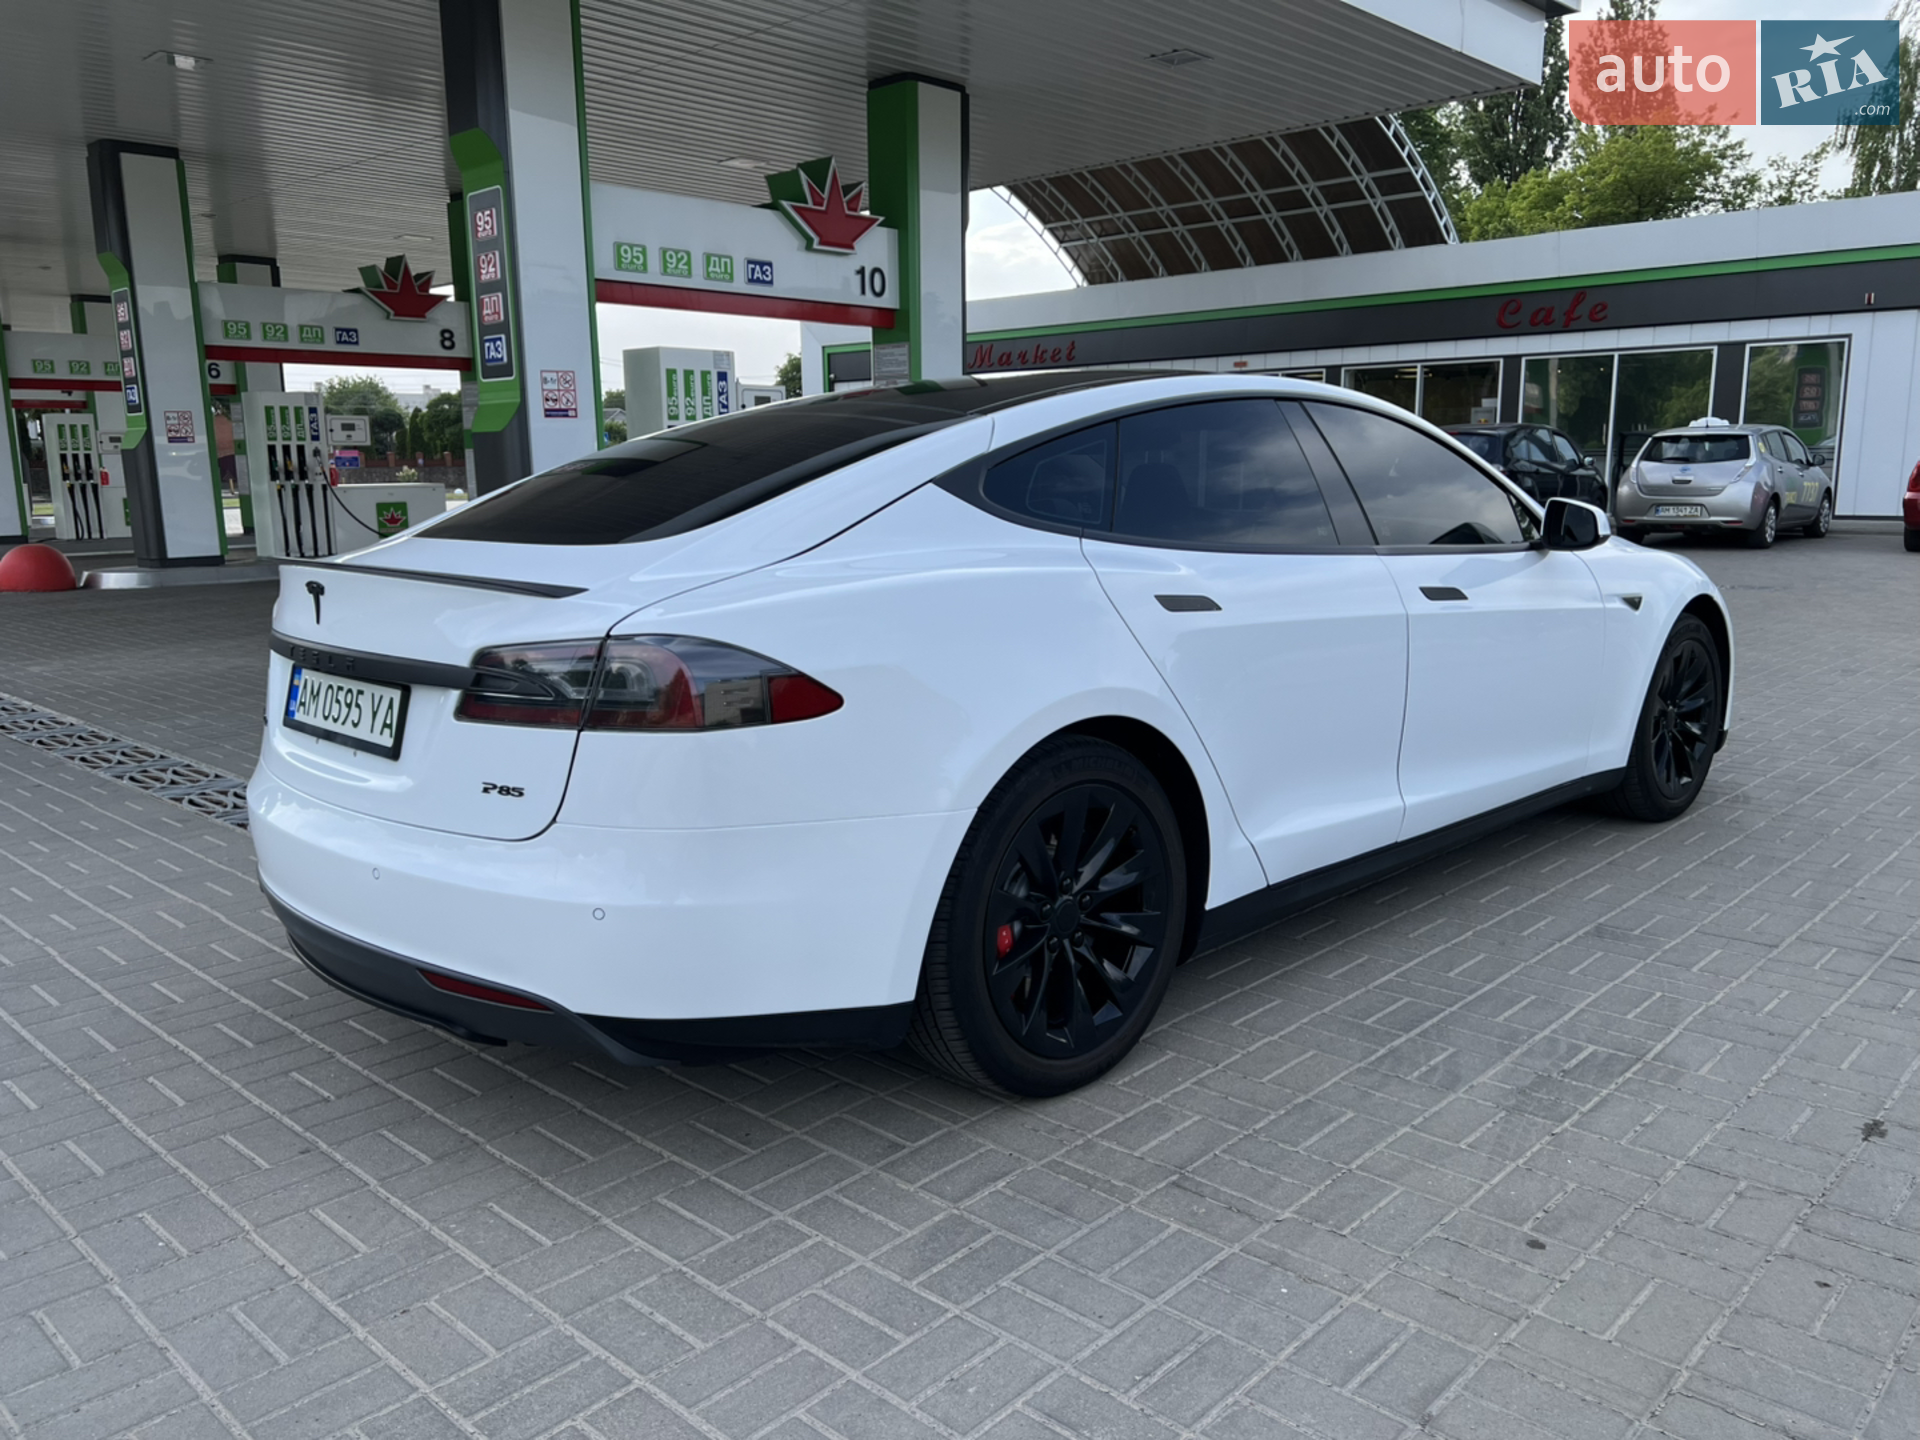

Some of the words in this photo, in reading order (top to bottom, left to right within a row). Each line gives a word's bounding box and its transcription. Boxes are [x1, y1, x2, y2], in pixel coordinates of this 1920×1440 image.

[476, 210, 492, 231] 95
[477, 229, 492, 238] euro
[479, 253, 495, 274] 92
[620, 245, 644, 264] 95
[665, 251, 688, 269] 92
[621, 263, 644, 271] euro
[666, 267, 688, 276] euro
[708, 257, 731, 273] ДП
[747, 264, 772, 281] ГАЗ
[480, 272, 496, 280] euro
[709, 272, 730, 280] euro
[855, 266, 887, 297] 10
[482, 296, 499, 315] ДП
[1496, 290, 1608, 329] Cafe
[227, 322, 247, 335] 95
[265, 324, 285, 337] 92
[302, 326, 321, 338] ДП
[336, 331, 357, 342] ГАЗ
[439, 329, 456, 350] 8
[484, 340, 503, 360] ГАЗ
[967, 341, 1075, 369] Market
[35, 361, 52, 371] 95
[71, 362, 87, 371] 92
[207, 362, 221, 379] 6
[703, 396, 713, 416] ДП
[719, 381, 728, 413] ГАЗ
[668, 397, 678, 416] 95
[685, 397, 696, 416] 92
[310, 413, 319, 436] ГАЗ
[297, 678, 322, 718] AM
[322, 684, 365, 728] 0595
[370, 692, 393, 738] YA
[481, 782, 525, 798] P85
